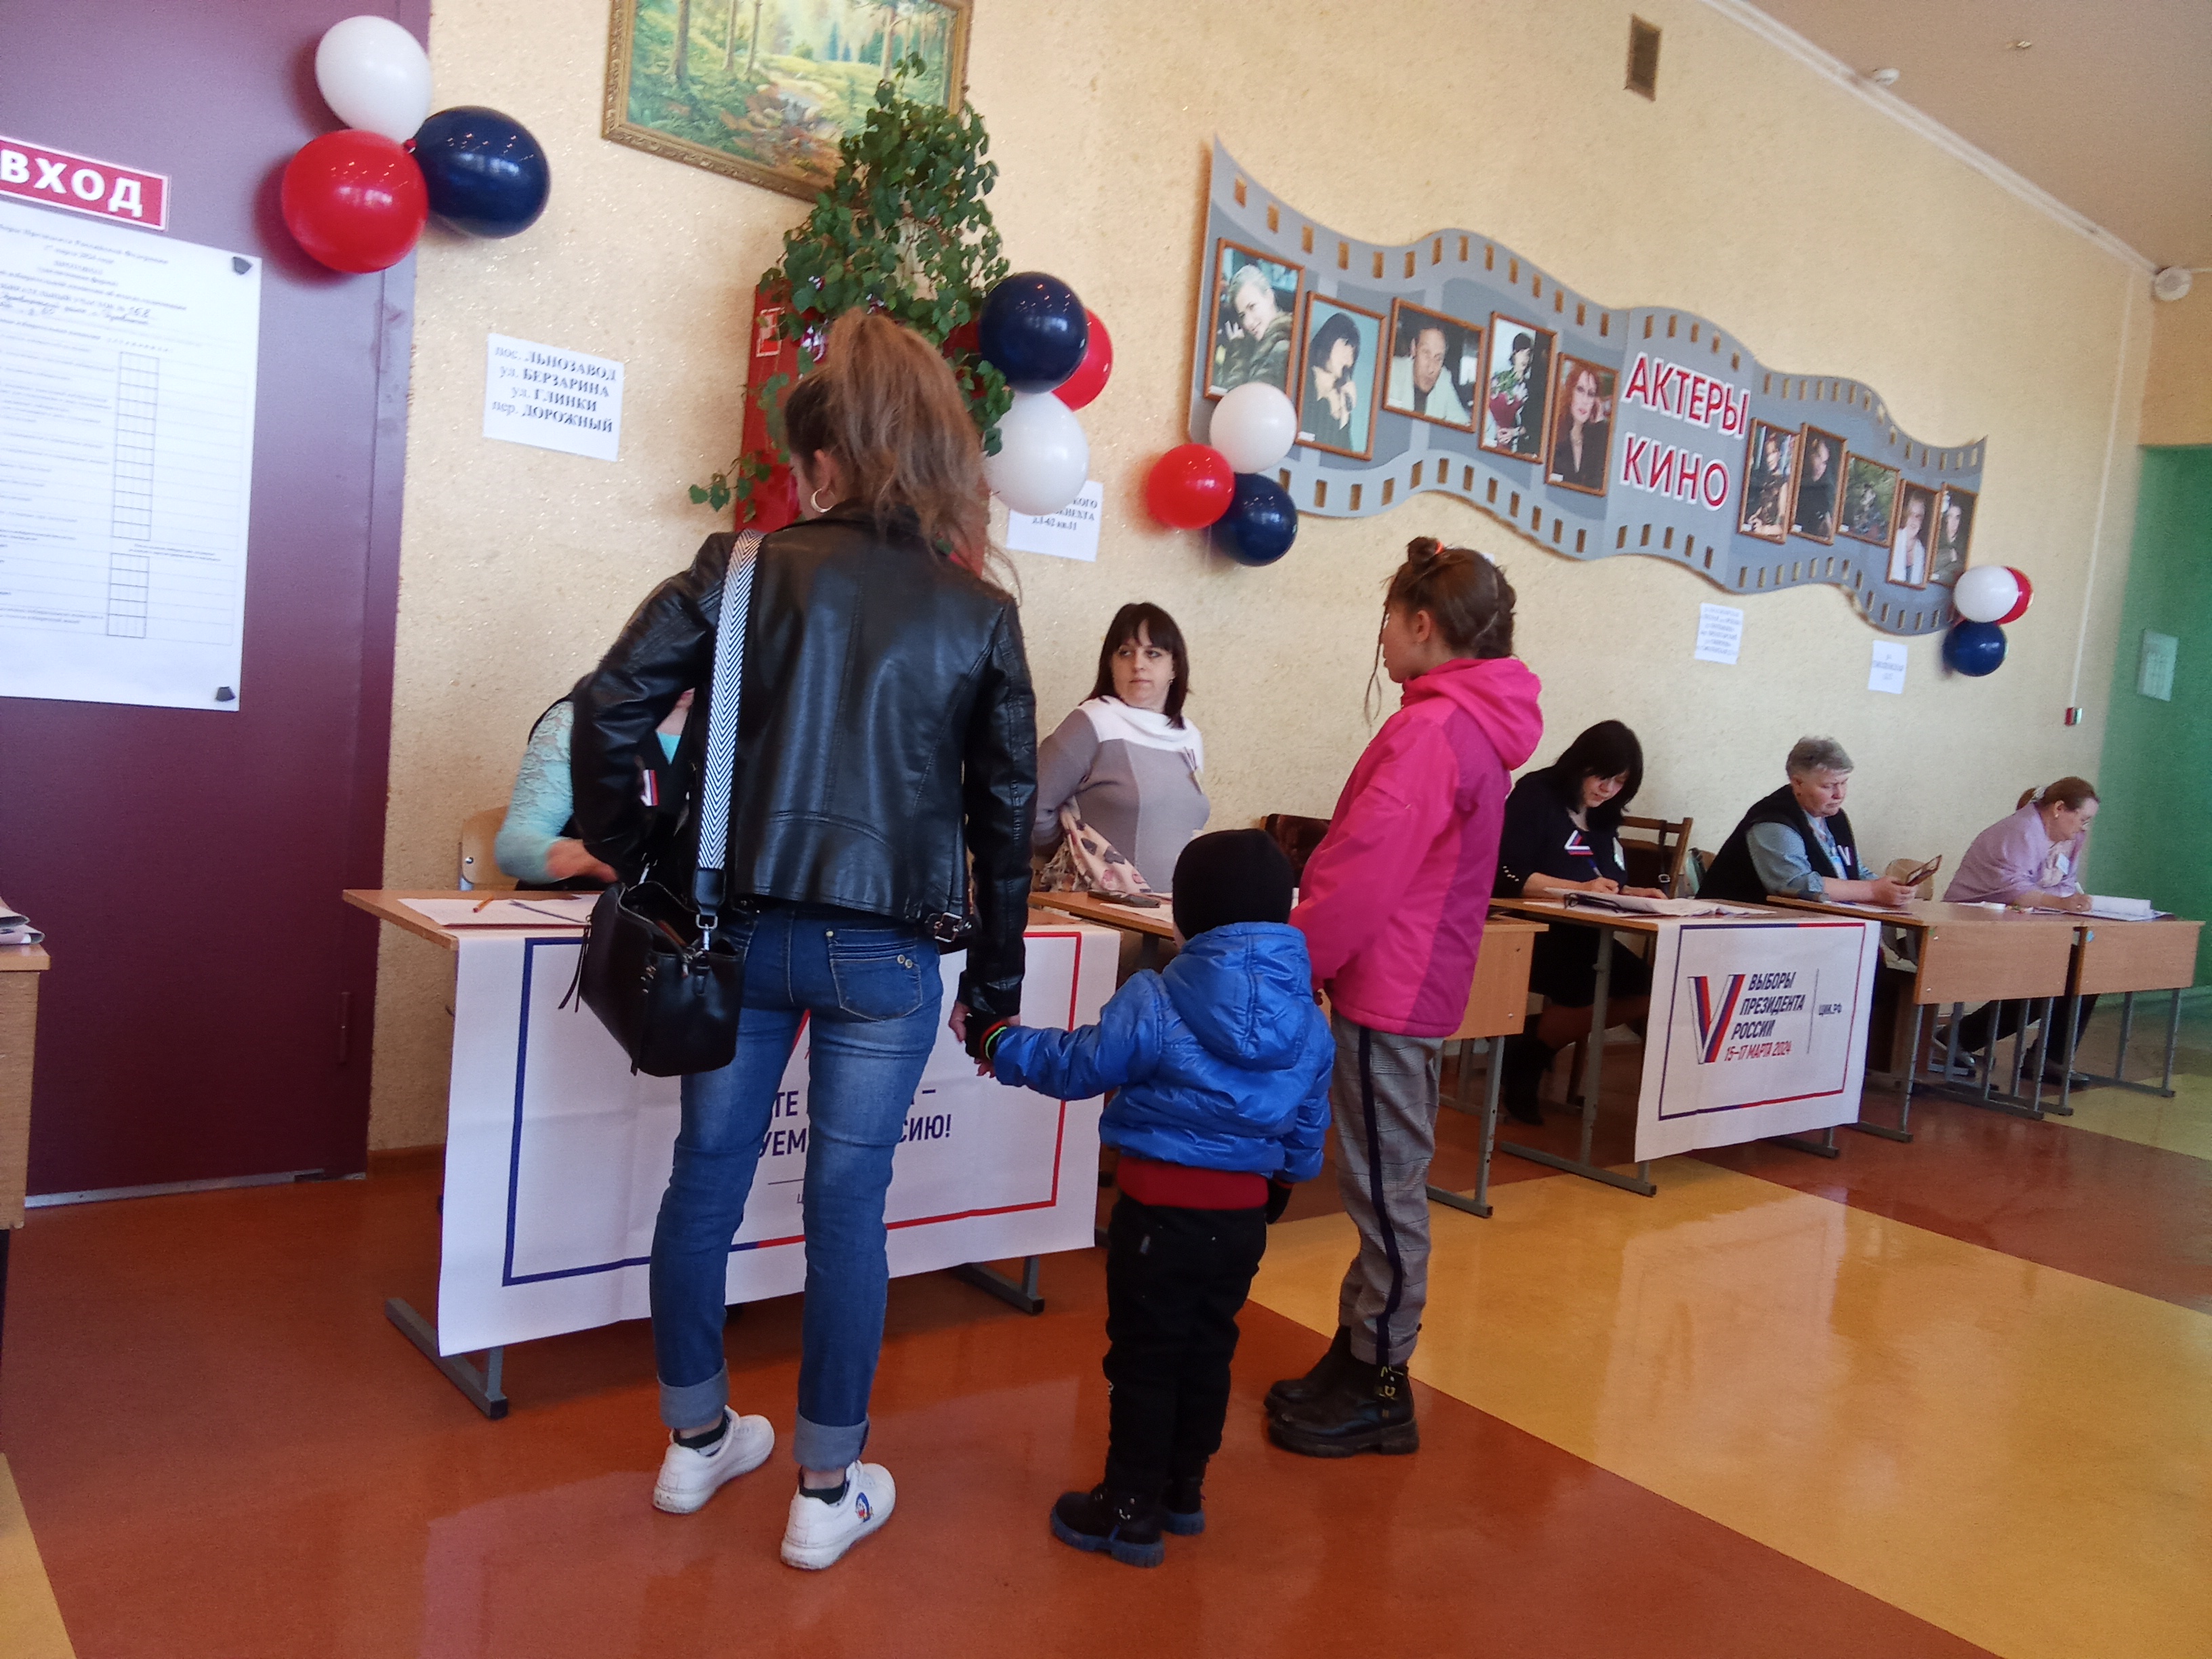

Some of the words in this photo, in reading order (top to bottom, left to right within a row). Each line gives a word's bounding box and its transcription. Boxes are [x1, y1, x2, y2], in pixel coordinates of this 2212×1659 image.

[1, 148, 143, 218] ВХОД
[495, 346, 521, 360] пос.
[525, 351, 617, 380] ЛЬНОЗАВОД
[499, 366, 518, 377] ул.
[523, 368, 609, 397] БЕРЗАРИНА
[1624, 355, 1750, 436] АКТЕРЫ
[511, 386, 530, 398] ул.
[534, 388, 597, 411] ГЛИНКИ
[492, 401, 518, 415] пер.
[521, 404, 613, 433] ДОРОЖНЫЙ
[1623, 435, 1729, 508] КИНО
[1073, 497, 1097, 509] КОГО
[1748, 972, 1797, 991] ВЫБОРЫ
[1740, 994, 1805, 1016] ПРЕЗИДЕНТА
[1731, 1019, 1776, 1040] РОССИИ
[1746, 1042, 1773, 1059] МАРТА
[1771, 1041, 1792, 1057] 2024
[775, 1090, 799, 1118] ТЕ
[758, 1128, 807, 1158] УЕМ
